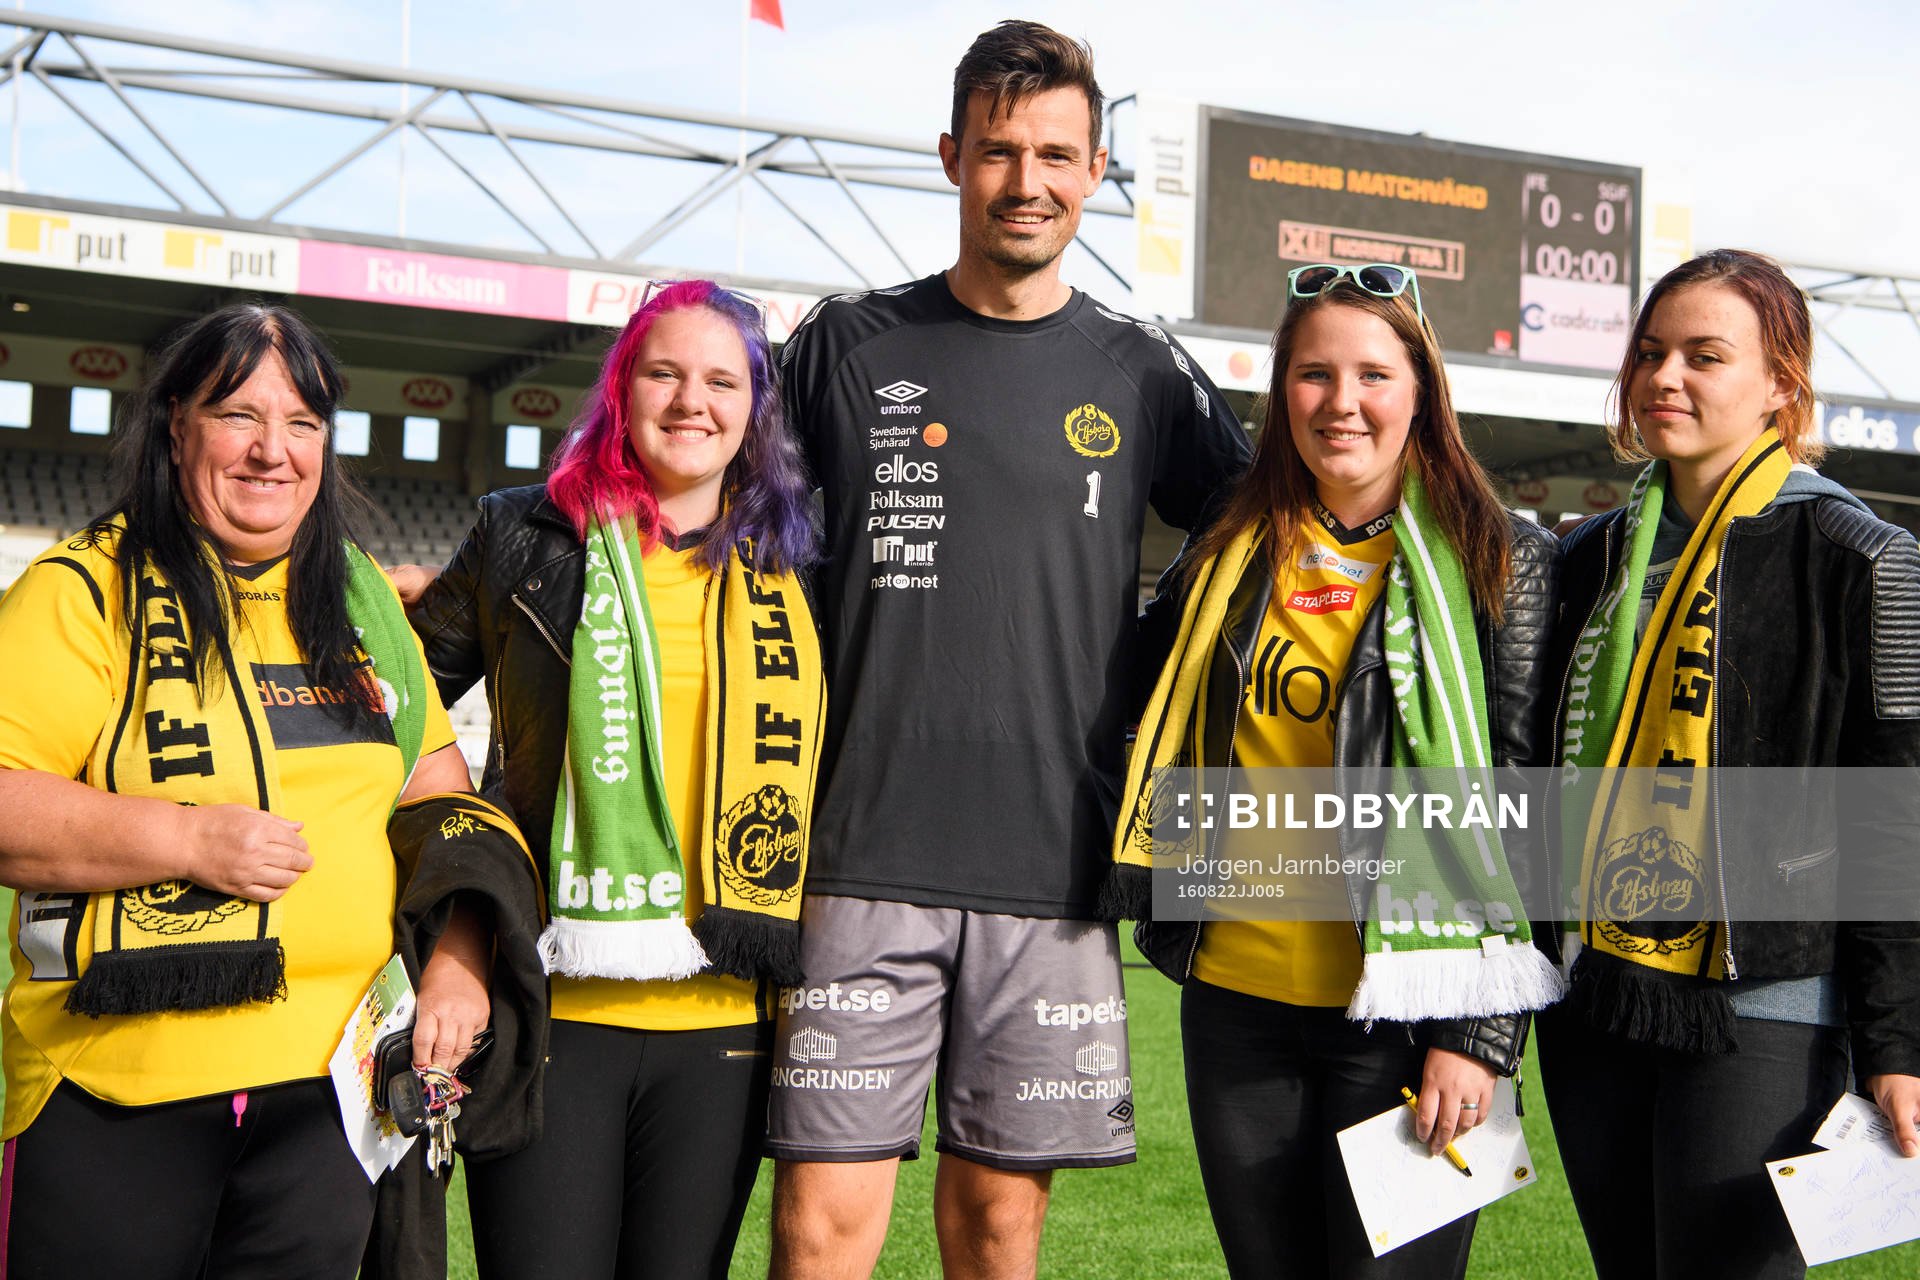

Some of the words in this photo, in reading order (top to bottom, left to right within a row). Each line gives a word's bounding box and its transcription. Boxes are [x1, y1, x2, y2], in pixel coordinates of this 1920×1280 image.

[1249, 156, 1344, 191] DAGENS
[1540, 194, 1561, 228] 0
[1594, 201, 1615, 235] 0
[77, 231, 127, 263] put
[229, 248, 277, 280] put
[366, 256, 507, 304] Folksam
[1535, 244, 1618, 284] 00:00
[880, 404, 922, 415] umbro
[869, 437, 910, 451] Sjuhärad
[870, 426, 919, 437] Swedbank
[1829, 406, 1899, 450] ellos
[875, 454, 939, 483] ellos
[869, 489, 944, 510] Folksam
[1083, 470, 1102, 519] 1
[867, 514, 946, 531] PULSEN
[239, 591, 281, 602] BORÅS
[1292, 590, 1354, 608] STAPLES
[1242, 635, 1343, 723] llo
[145, 710, 215, 783] IF
[755, 702, 801, 767] IF
[558, 861, 682, 911] bt.se
[1377, 884, 1517, 938] bt.se
[779, 983, 890, 1015] apet.se
[1034, 996, 1127, 1031] tapet.s
[771, 1067, 891, 1090] RNGRINDEN
[1015, 1077, 1132, 1102] JÄRNGRIND
